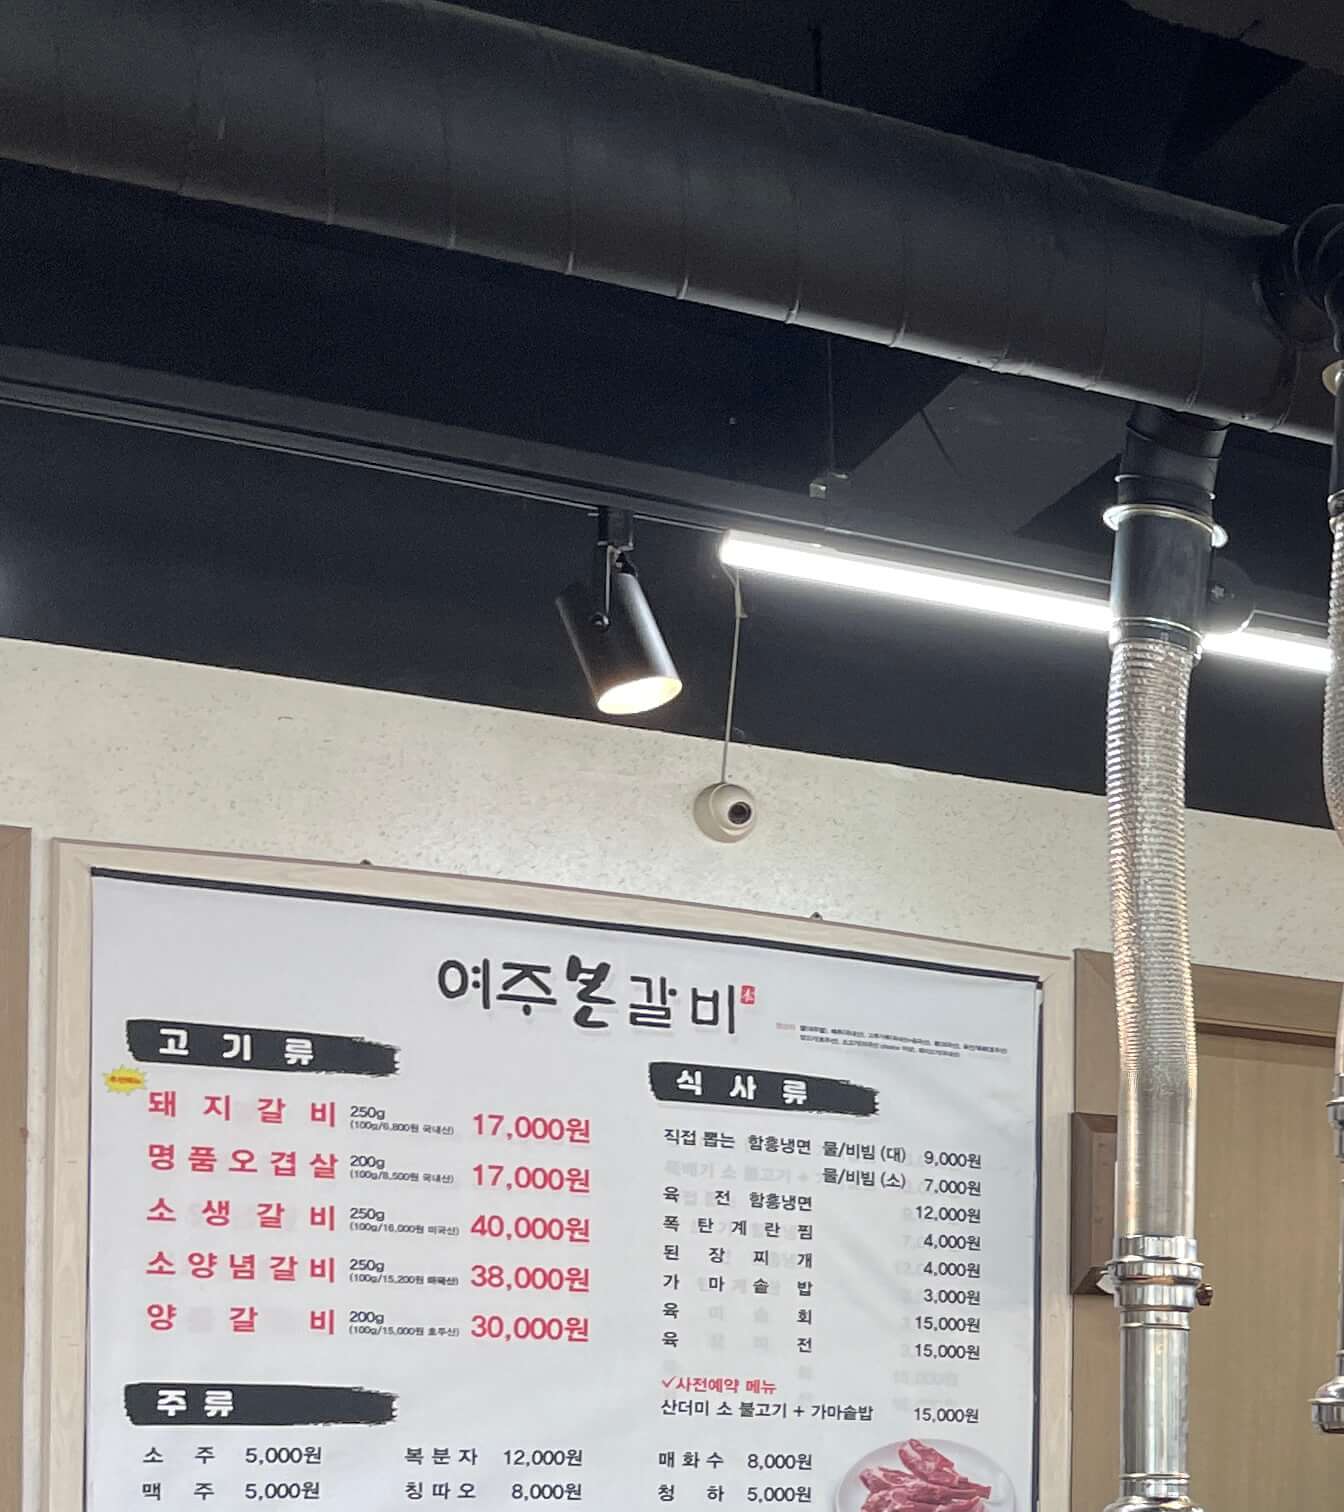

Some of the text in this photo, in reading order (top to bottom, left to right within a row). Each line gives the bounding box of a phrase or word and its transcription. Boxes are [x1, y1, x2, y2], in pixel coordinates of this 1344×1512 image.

[351, 1106, 385, 1123] 250g
[475, 1115, 589, 1143] 17,000원
[664, 1129, 981, 1169] 직접 뽑는 함흥냉면 물/비빔 (대) 9,000원
[351, 1155, 384, 1172] 200g
[475, 1165, 589, 1192] 17,000원
[823, 1168, 980, 1196] 물/비빔 (소) 7,000원
[750, 1192, 811, 1211] 함흥냉면
[916, 1206, 980, 1223] 12,000원
[350, 1208, 384, 1224] 250g
[471, 1216, 589, 1242] 40,000원
[924, 1234, 980, 1251] 4,000원
[350, 1259, 384, 1275] 250g
[471, 1265, 590, 1293] 38,000원
[924, 1262, 980, 1278] 4,000원
[924, 1289, 980, 1305] 3,000원
[350, 1311, 384, 1327] 200g
[471, 1315, 590, 1343] 30,000원
[916, 1316, 980, 1332] 15,000원
[916, 1344, 979, 1360] 15,000원
[746, 1380, 777, 1396] 메뉴
[661, 1400, 708, 1416] 산더미
[717, 1402, 732, 1415] 소
[739, 1402, 786, 1418] 불고기
[812, 1405, 873, 1421] 가마솥밥
[915, 1408, 978, 1423] 15,000원
[246, 1447, 321, 1464] 5,000원
[504, 1450, 582, 1466] 12,000원
[748, 1454, 811, 1470] 8,000원
[246, 1482, 319, 1500] 5,000원
[512, 1484, 581, 1500] 8,000원
[748, 1487, 811, 1502] 5,000원
